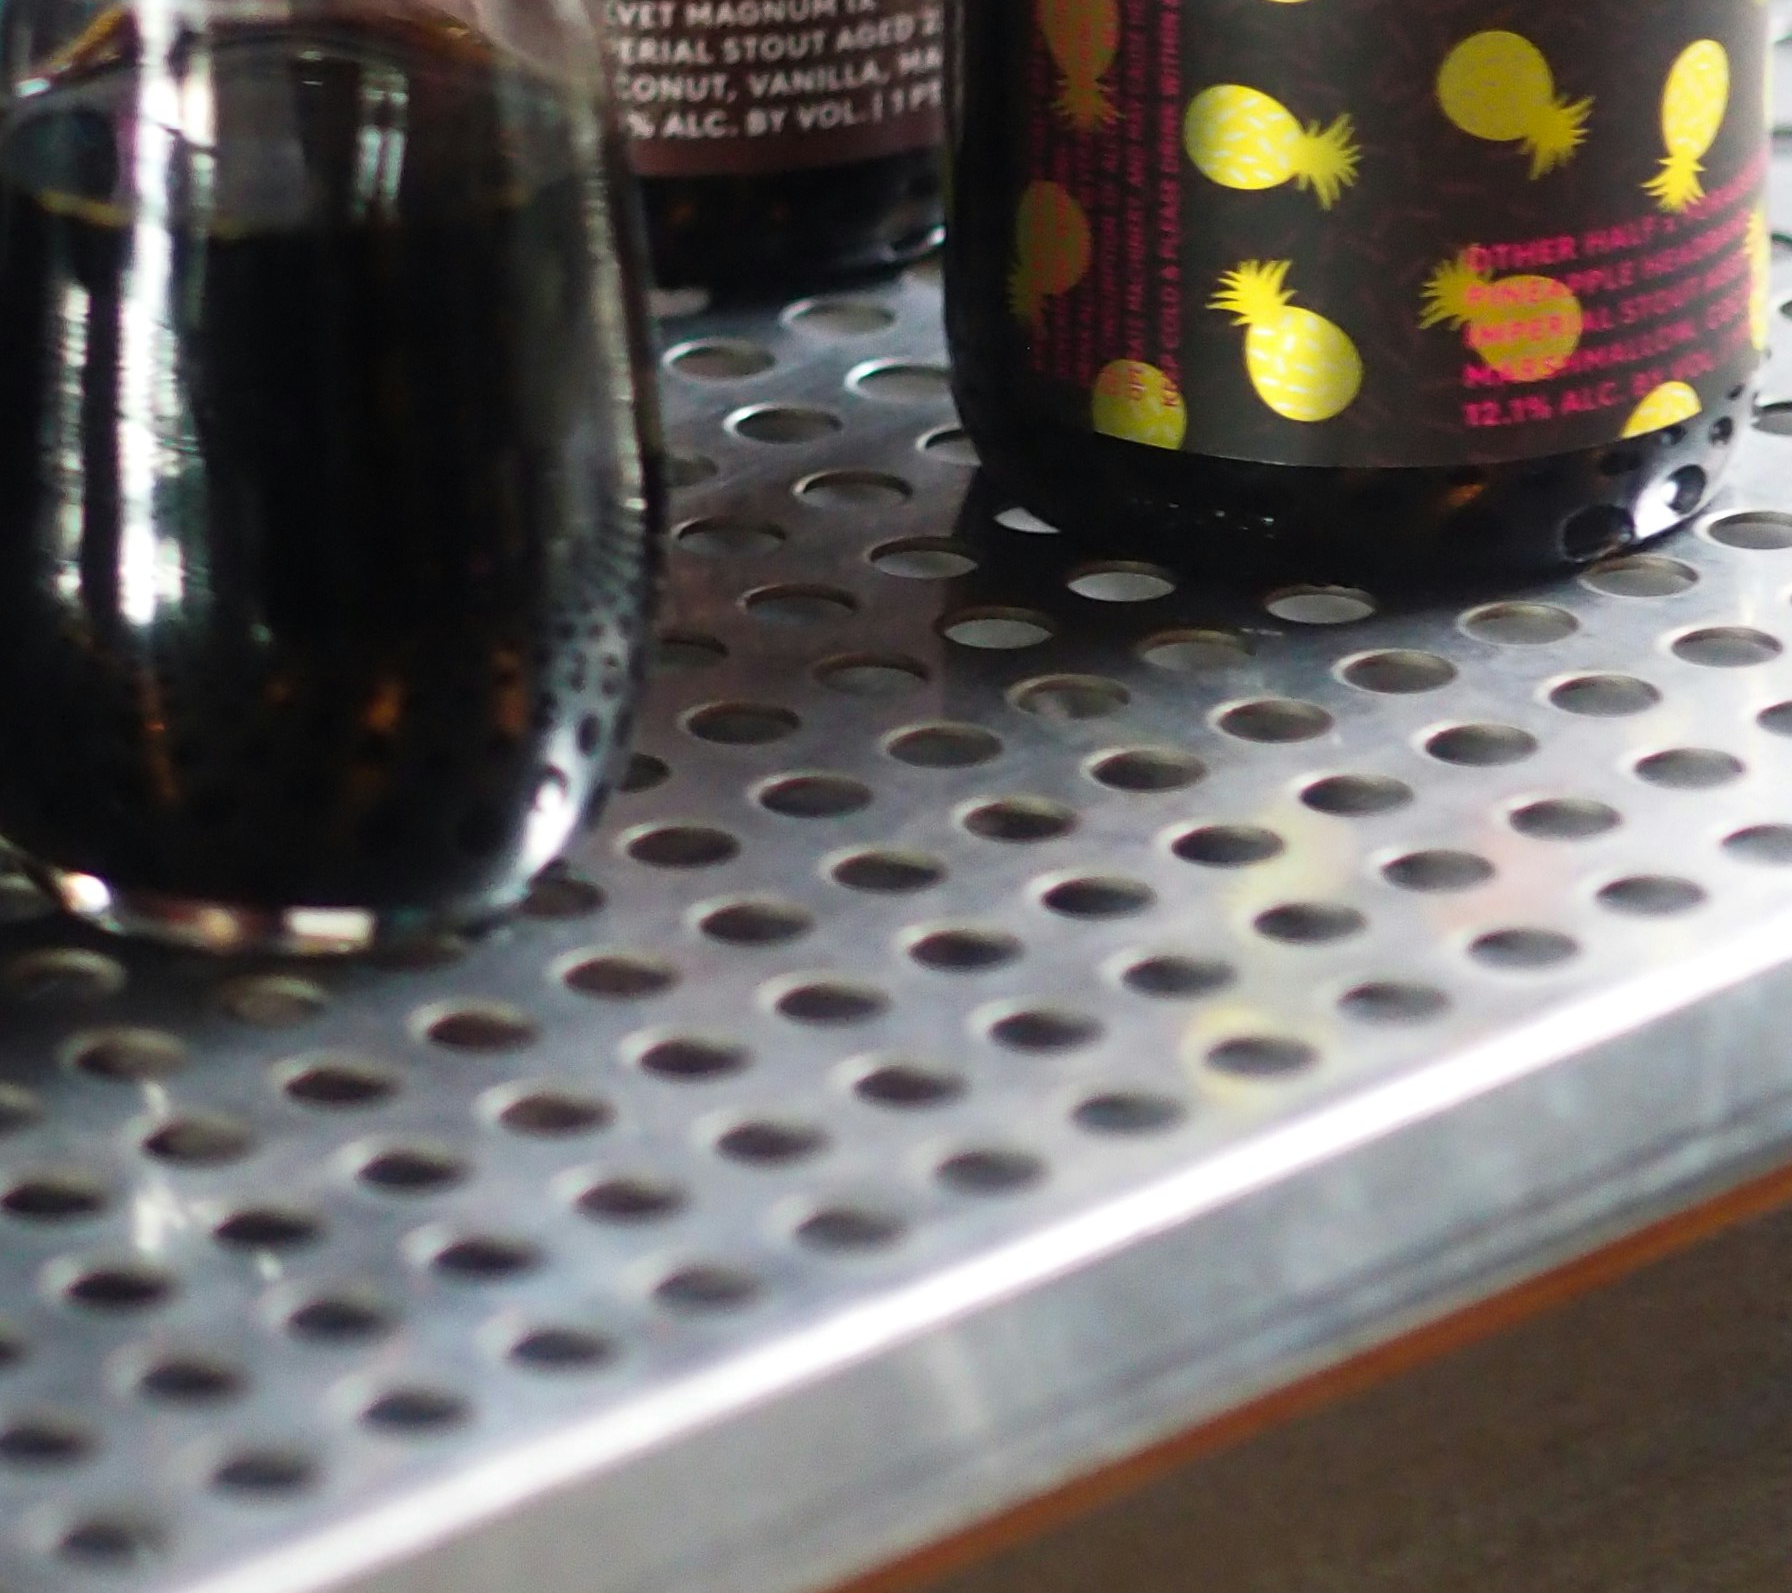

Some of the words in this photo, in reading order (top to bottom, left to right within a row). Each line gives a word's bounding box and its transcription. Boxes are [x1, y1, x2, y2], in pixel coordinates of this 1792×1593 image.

[722, 29, 826, 63] STOUT
[836, 12, 916, 53] AGED
[662, 110, 739, 140] ALC.
[746, 107, 787, 138] BY
[1466, 235, 1576, 271] OTHER
[1584, 216, 1656, 255] HALF
[1157, 286, 1182, 350] COLD
